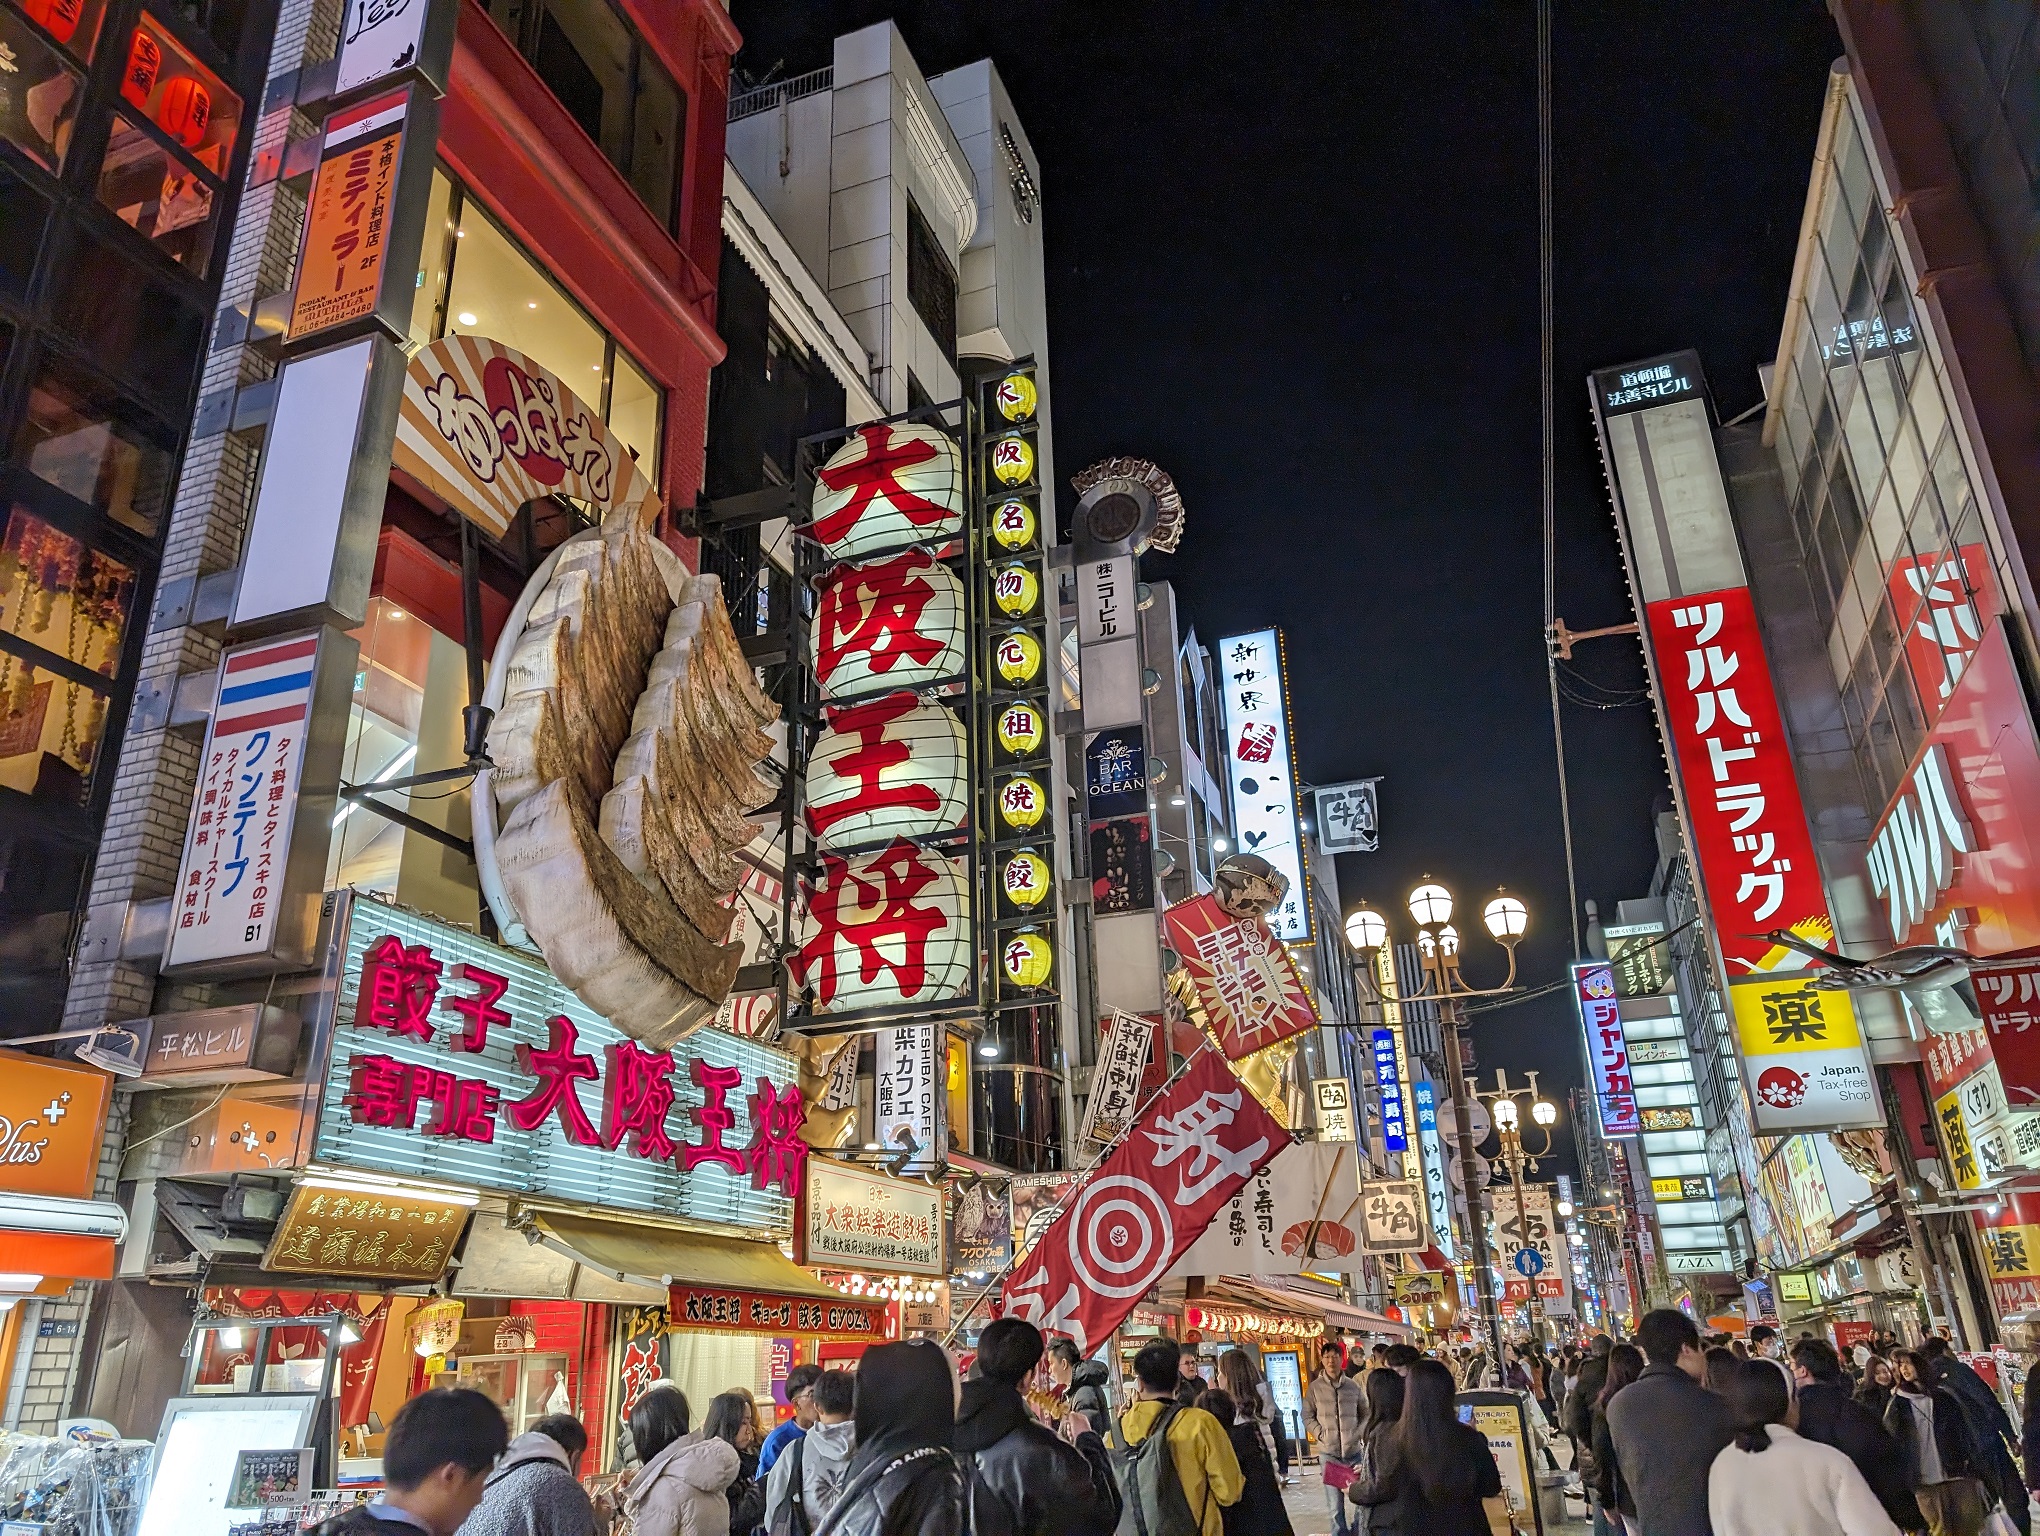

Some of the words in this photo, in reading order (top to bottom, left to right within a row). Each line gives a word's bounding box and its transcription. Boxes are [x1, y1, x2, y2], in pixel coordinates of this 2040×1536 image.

[366, 139, 395, 248] 本格インド料理店
[331, 149, 374, 293] ミティラー
[360, 253, 378, 271] 2F
[297, 294, 349, 316] RESTAURANT
[358, 284, 375, 296] BAR
[298, 295, 327, 309] INDIAN
[1606, 376, 1693, 407] 法善寺ビル
[1620, 364, 1672, 388] 道頓堀
[1230, 641, 1269, 713] 新世界
[784, 422, 962, 1008] 大阪王将
[1099, 760, 1132, 775] BAR
[1669, 600, 1792, 923] ツルハドラッグ
[195, 752, 223, 847] タイ調味料
[1089, 778, 1146, 796] OCEAN
[197, 747, 240, 926] タイカルチャースクール
[221, 730, 272, 899] クンテープ
[247, 736, 292, 920] タイ料理とタイスキの店
[1866, 745, 1968, 944] ツルハ
[180, 869, 203, 930] 食材店
[244, 923, 263, 943] B1
[355, 934, 512, 1054] 餃子
[1195, 931, 1262, 1037] ミュージアム
[1760, 989, 1829, 1045] 薬
[158, 1026, 246, 1062] 平松ビル
[1593, 1002, 1636, 1122] ジャンカラ
[1635, 1050, 1677, 1061] レインボー
[1102, 1020, 1149, 1117] 新鮮刺身
[1817, 1078, 1868, 1091] Tax-free
[1820, 1065, 1865, 1078] Japan.
[343, 1054, 501, 1146] 専門店
[502, 1014, 809, 1200] 大阪王将
[879, 1071, 893, 1117] 大阪店
[920, 1092, 931, 1137] CAFE
[1322, 1087, 1346, 1105] 牛角
[1416, 1088, 1435, 1124] 焼肉
[1839, 1090, 1871, 1102] Shop
[1966, 1080, 1992, 1118] くすり
[1141, 1087, 1270, 1207] 射
[1941, 1103, 1977, 1183] 薬
[869, 1185, 892, 1205] 日本一
[1013, 1174, 1068, 1188] MAMESHIBA
[1423, 1142, 1450, 1244] いろりや
[306, 1193, 456, 1232] 創業昭和四十四年
[810, 1178, 822, 1245] 景品付
[823, 1199, 930, 1247] 大衆娯楽遊戯場
[930, 1203, 939, 1260] 景品付
[1366, 1197, 1417, 1235] 牛角
[281, 1224, 446, 1272] 道頓堀本店
[959, 1246, 1005, 1259] フクロウの森
[968, 1258, 996, 1266] OSAKA
[1676, 1257, 1715, 1269] ZAZA
[1986, 1230, 2030, 1273] 薬
[56, 1324, 77, 1335] 6-14
[685, 1292, 742, 1325] 大阪王将
[797, 1302, 823, 1330] 餃子
[828, 1306, 871, 1332] GYOZA
[917, 1312, 933, 1326] 大阪店
